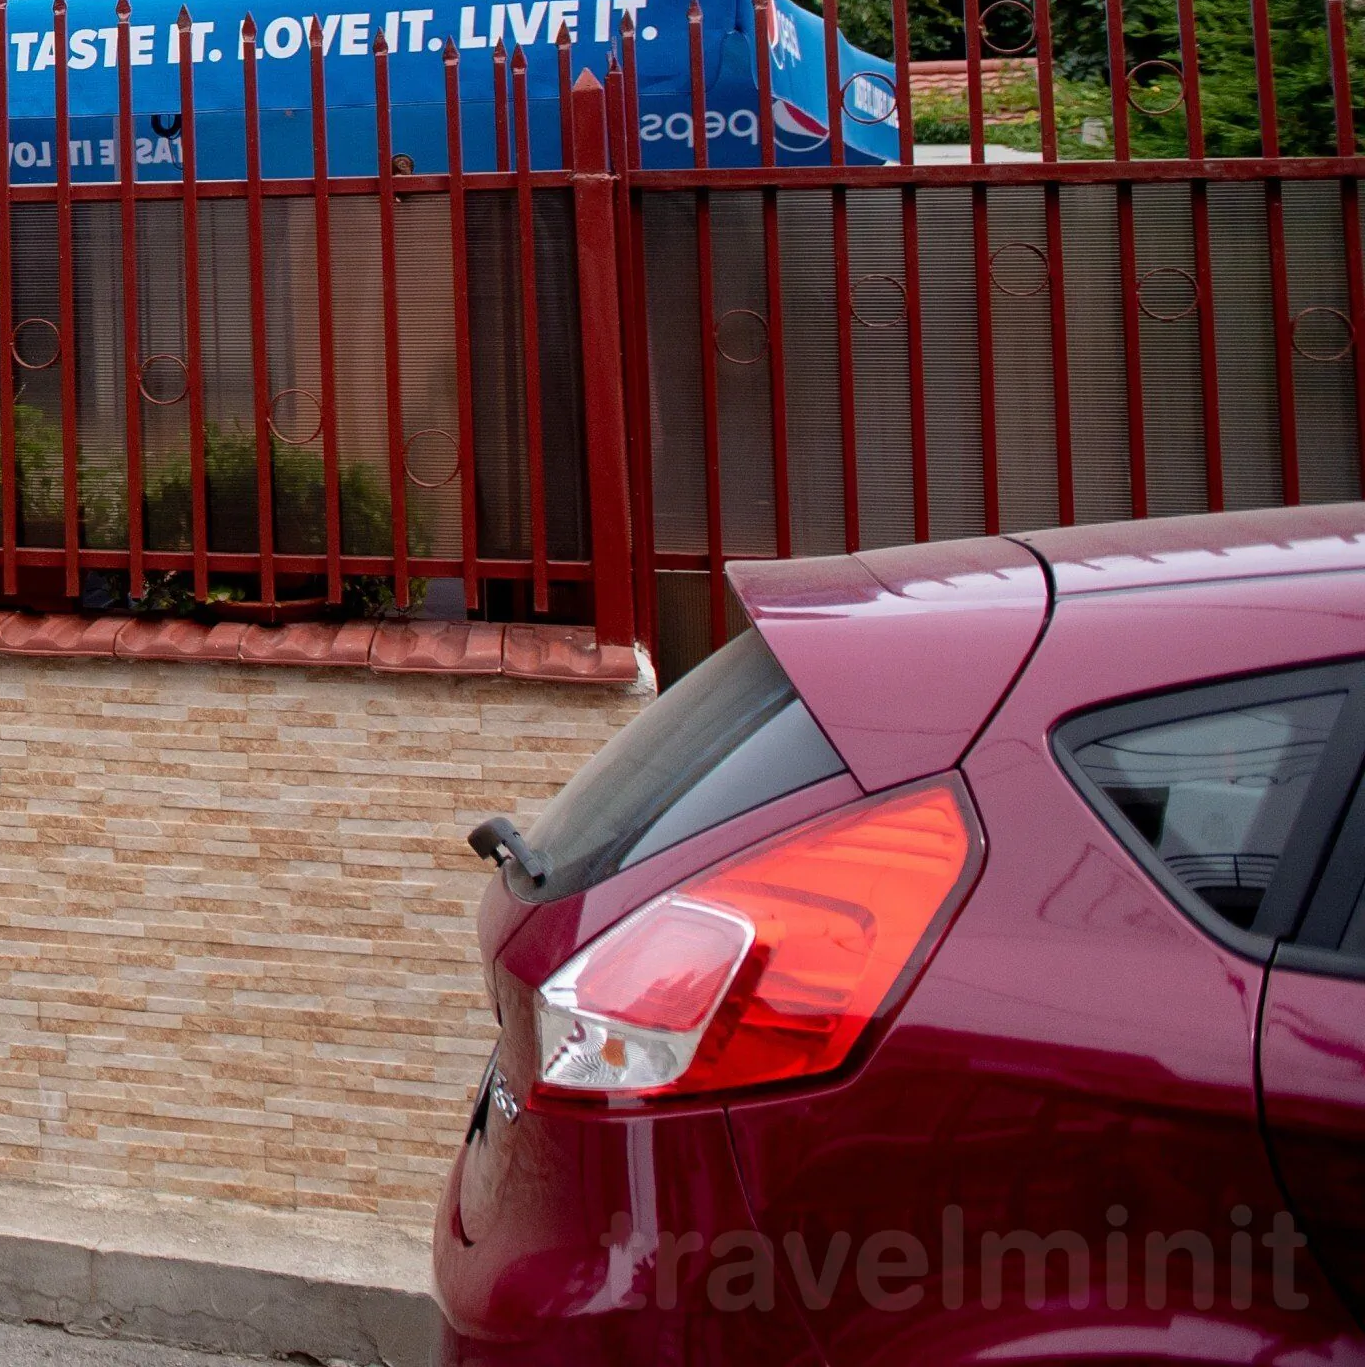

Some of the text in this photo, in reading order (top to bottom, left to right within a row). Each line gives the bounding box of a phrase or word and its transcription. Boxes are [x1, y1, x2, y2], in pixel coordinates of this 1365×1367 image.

[10, 24, 156, 72] TASTE
[237, 13, 370, 60] LOVE
[459, 0, 579, 49] LIVE
